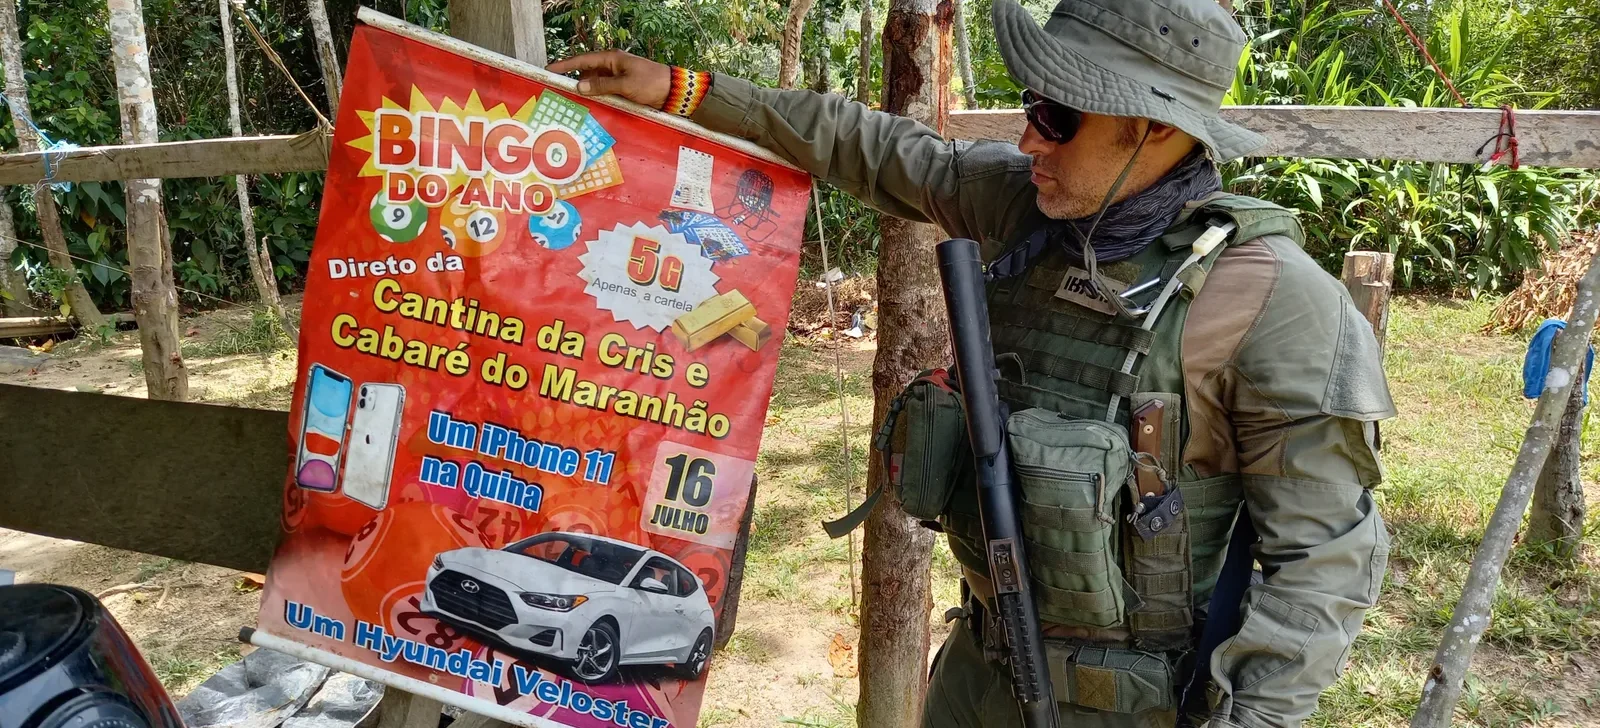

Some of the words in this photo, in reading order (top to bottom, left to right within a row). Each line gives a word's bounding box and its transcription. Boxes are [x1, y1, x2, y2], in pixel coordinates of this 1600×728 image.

[377, 112, 584, 182] BINGO
[387, 171, 449, 204] DO
[460, 177, 554, 212] ANO
[391, 207, 406, 223] 9
[469, 216, 496, 238] 12
[327, 257, 417, 280] Direto
[426, 251, 465, 273] da
[627, 236, 684, 293] 5G
[591, 277, 637, 298] Apenas
[643, 291, 651, 302] a
[654, 293, 693, 313] cartela
[372, 278, 525, 345] Cantina
[536, 319, 586, 358] da
[598, 333, 676, 379] Cris
[686, 361, 710, 388] e
[330, 313, 471, 377] Cabaré
[480, 352, 530, 391] do
[539, 363, 731, 440] Maranhão
[427, 411, 478, 451] Um
[478, 422, 580, 477] iPhone
[583, 448, 617, 485] 11
[419, 455, 460, 489] na
[462, 461, 543, 514] Quina
[664, 453, 716, 508] 16
[650, 504, 710, 535] JULHO
[285, 600, 346, 642] Um
[354, 619, 504, 688] Hyundai
[513, 663, 669, 728] Veloster
